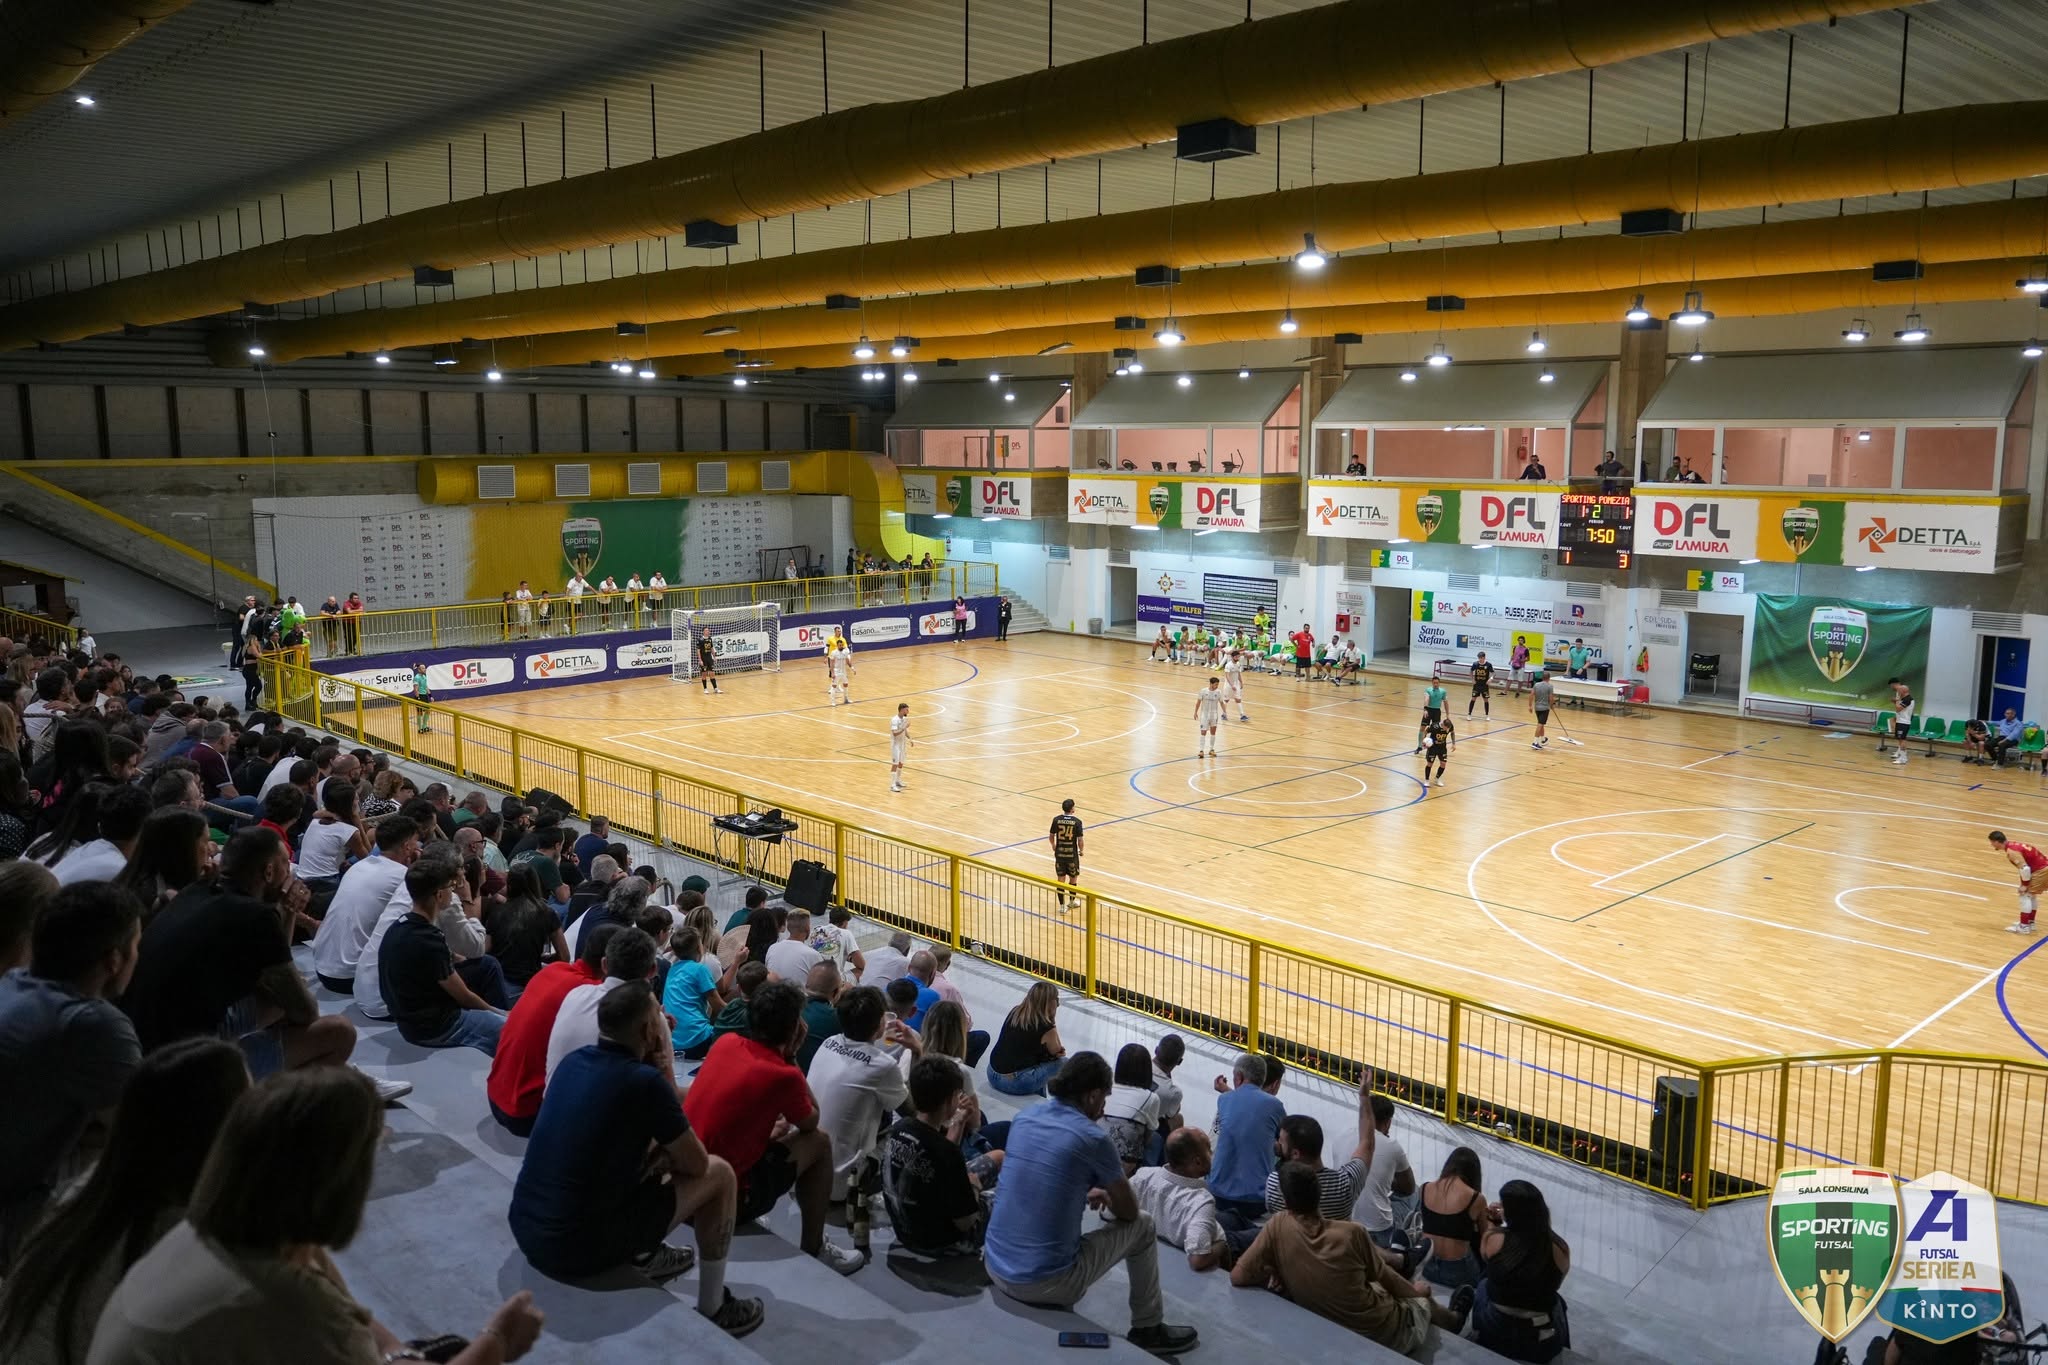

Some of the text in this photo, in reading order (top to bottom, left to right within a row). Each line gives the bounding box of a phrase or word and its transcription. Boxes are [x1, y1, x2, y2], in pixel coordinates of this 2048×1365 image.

[983, 480, 1020, 505] DFL
[1092, 496, 1123, 507] DETTA
[1197, 487, 1245, 516] DFL
[1561, 494, 1630, 505] SPORTING POMEZIA
[994, 507, 1020, 515] LAMURA
[1340, 506, 1380, 519] DETTA
[1481, 496, 1546, 529] DFL
[1582, 505, 1629, 519] 1 2 1
[1211, 517, 1245, 527] LAMURA
[1654, 502, 1730, 538] DFL
[1784, 521, 1817, 529] SPORTING
[1499, 532, 1544, 543] LAMURA
[1586, 528, 1615, 543] 7:50
[1898, 527, 1968, 545] DETTA
[565, 538, 599, 546] SPORTING
[1675, 540, 1729, 552] LAMURA
[1566, 552, 1570, 564] 1
[1619, 554, 1628, 568] 3
[1722, 577, 1739, 585] DFL
[1438, 602, 1453, 610] DFL
[1471, 606, 1498, 615] DETTA
[1505, 607, 1552, 619] RUSSO SERVICE
[799, 627, 824, 642] DFL
[1420, 625, 1445, 635] Santo
[726, 638, 746, 646] CASA
[1418, 634, 1449, 646] Stefano
[1814, 631, 1862, 644] SPORTING
[726, 644, 758, 653] SURACE
[556, 655, 593, 669] DETTA
[453, 662, 487, 680] DFL
[376, 673, 412, 684] Service
[1058, 825, 1074, 840] 24
